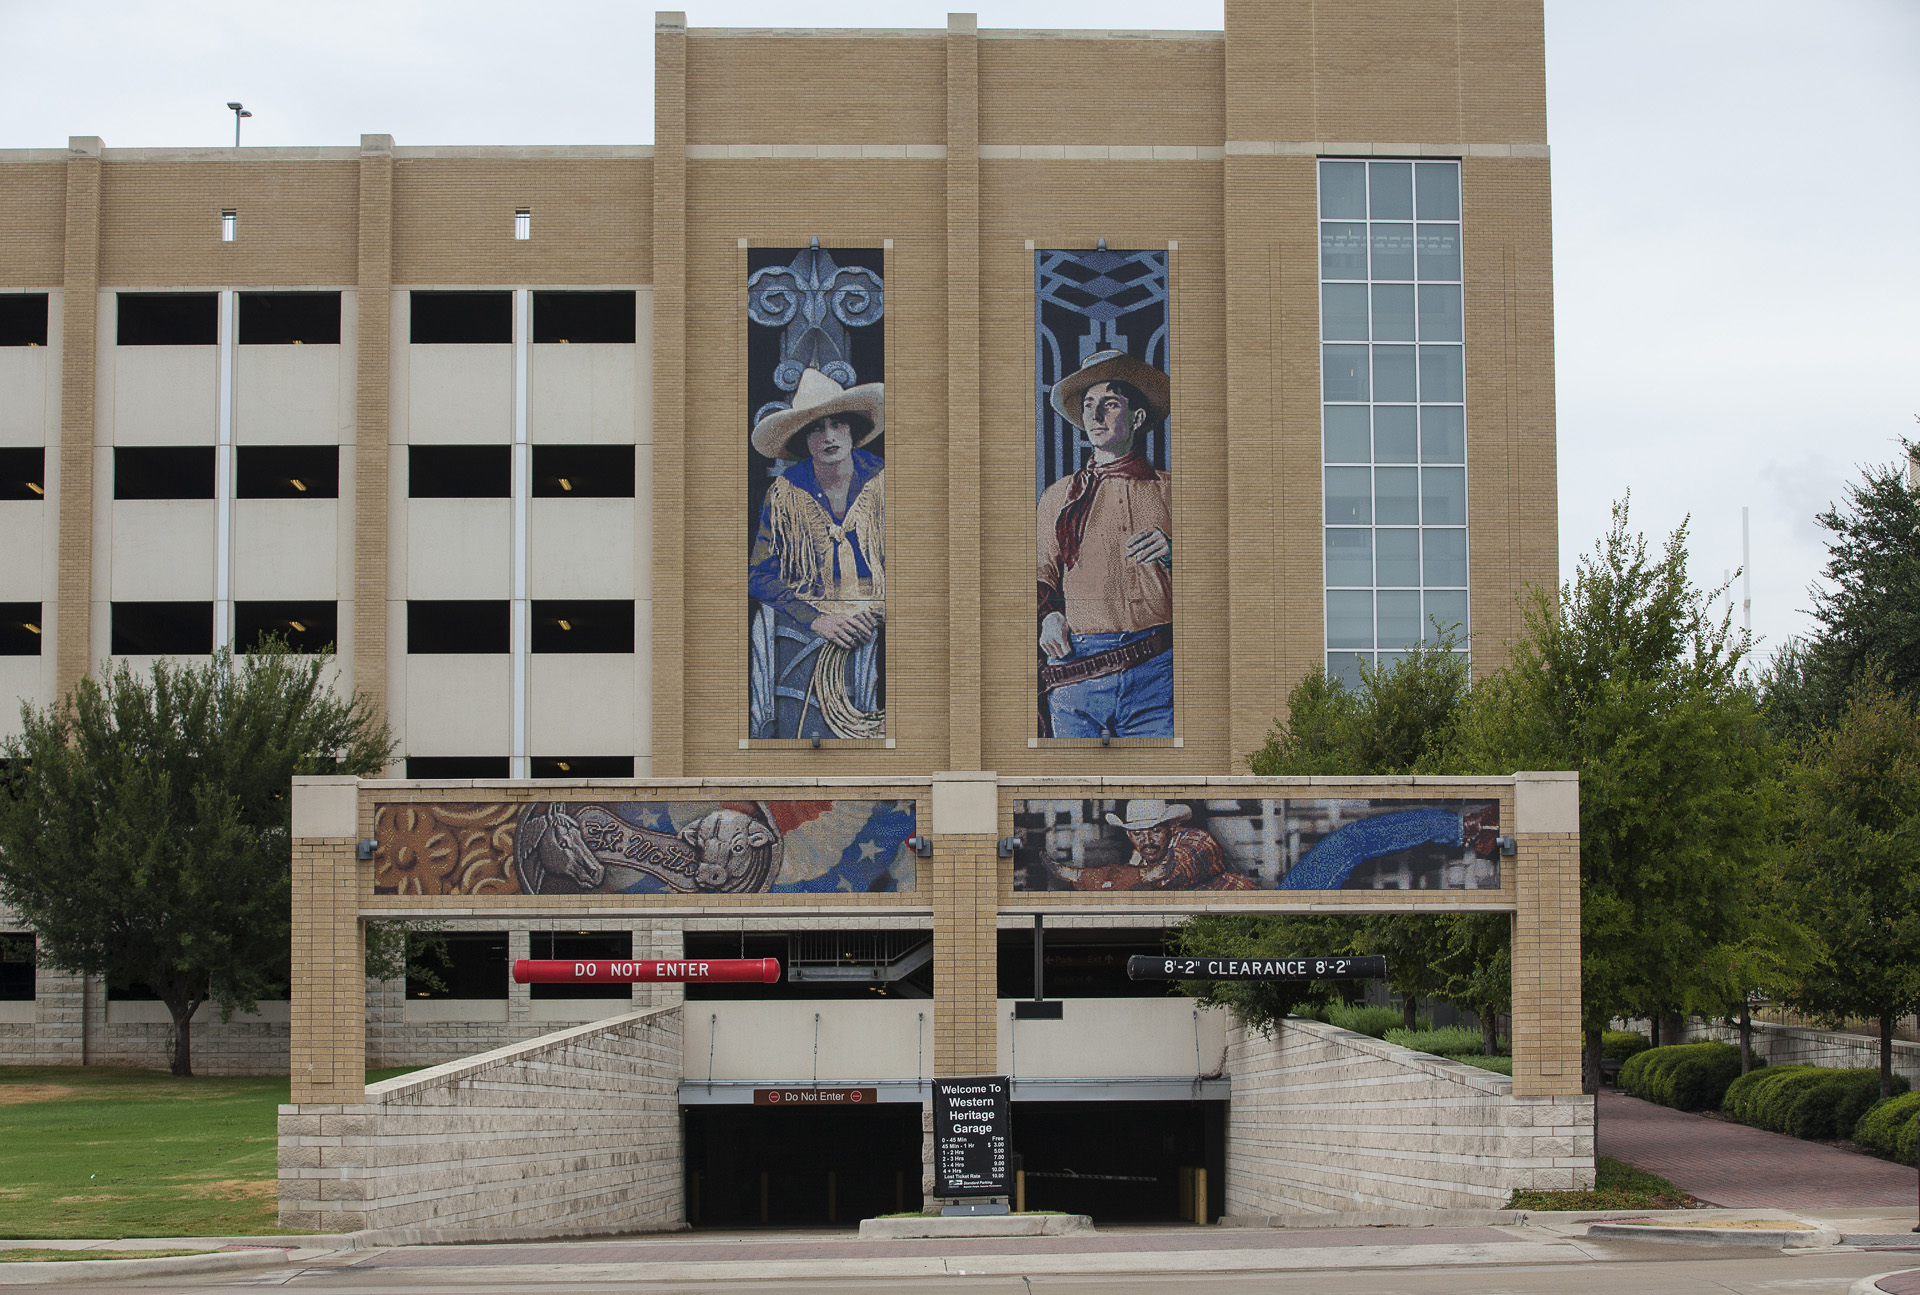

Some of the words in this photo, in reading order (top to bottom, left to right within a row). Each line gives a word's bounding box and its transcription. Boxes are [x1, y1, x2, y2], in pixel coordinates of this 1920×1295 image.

[575, 963, 597, 977] DO
[611, 963, 642, 977] NOT
[656, 963, 709, 977] ENTER
[1164, 960, 1201, 975] 8'-2"
[1208, 961, 1307, 975] CLEARANCE
[1315, 959, 1351, 974] 8'-2"
[941, 1085, 987, 1094] Welcome
[989, 1084, 1002, 1093] To
[785, 1092, 799, 1101] Do
[801, 1092, 817, 1101] Not
[820, 1091, 845, 1101] Enter
[949, 1097, 994, 1107] Western
[949, 1110, 995, 1122] Heritage
[953, 1124, 992, 1135] Garage
